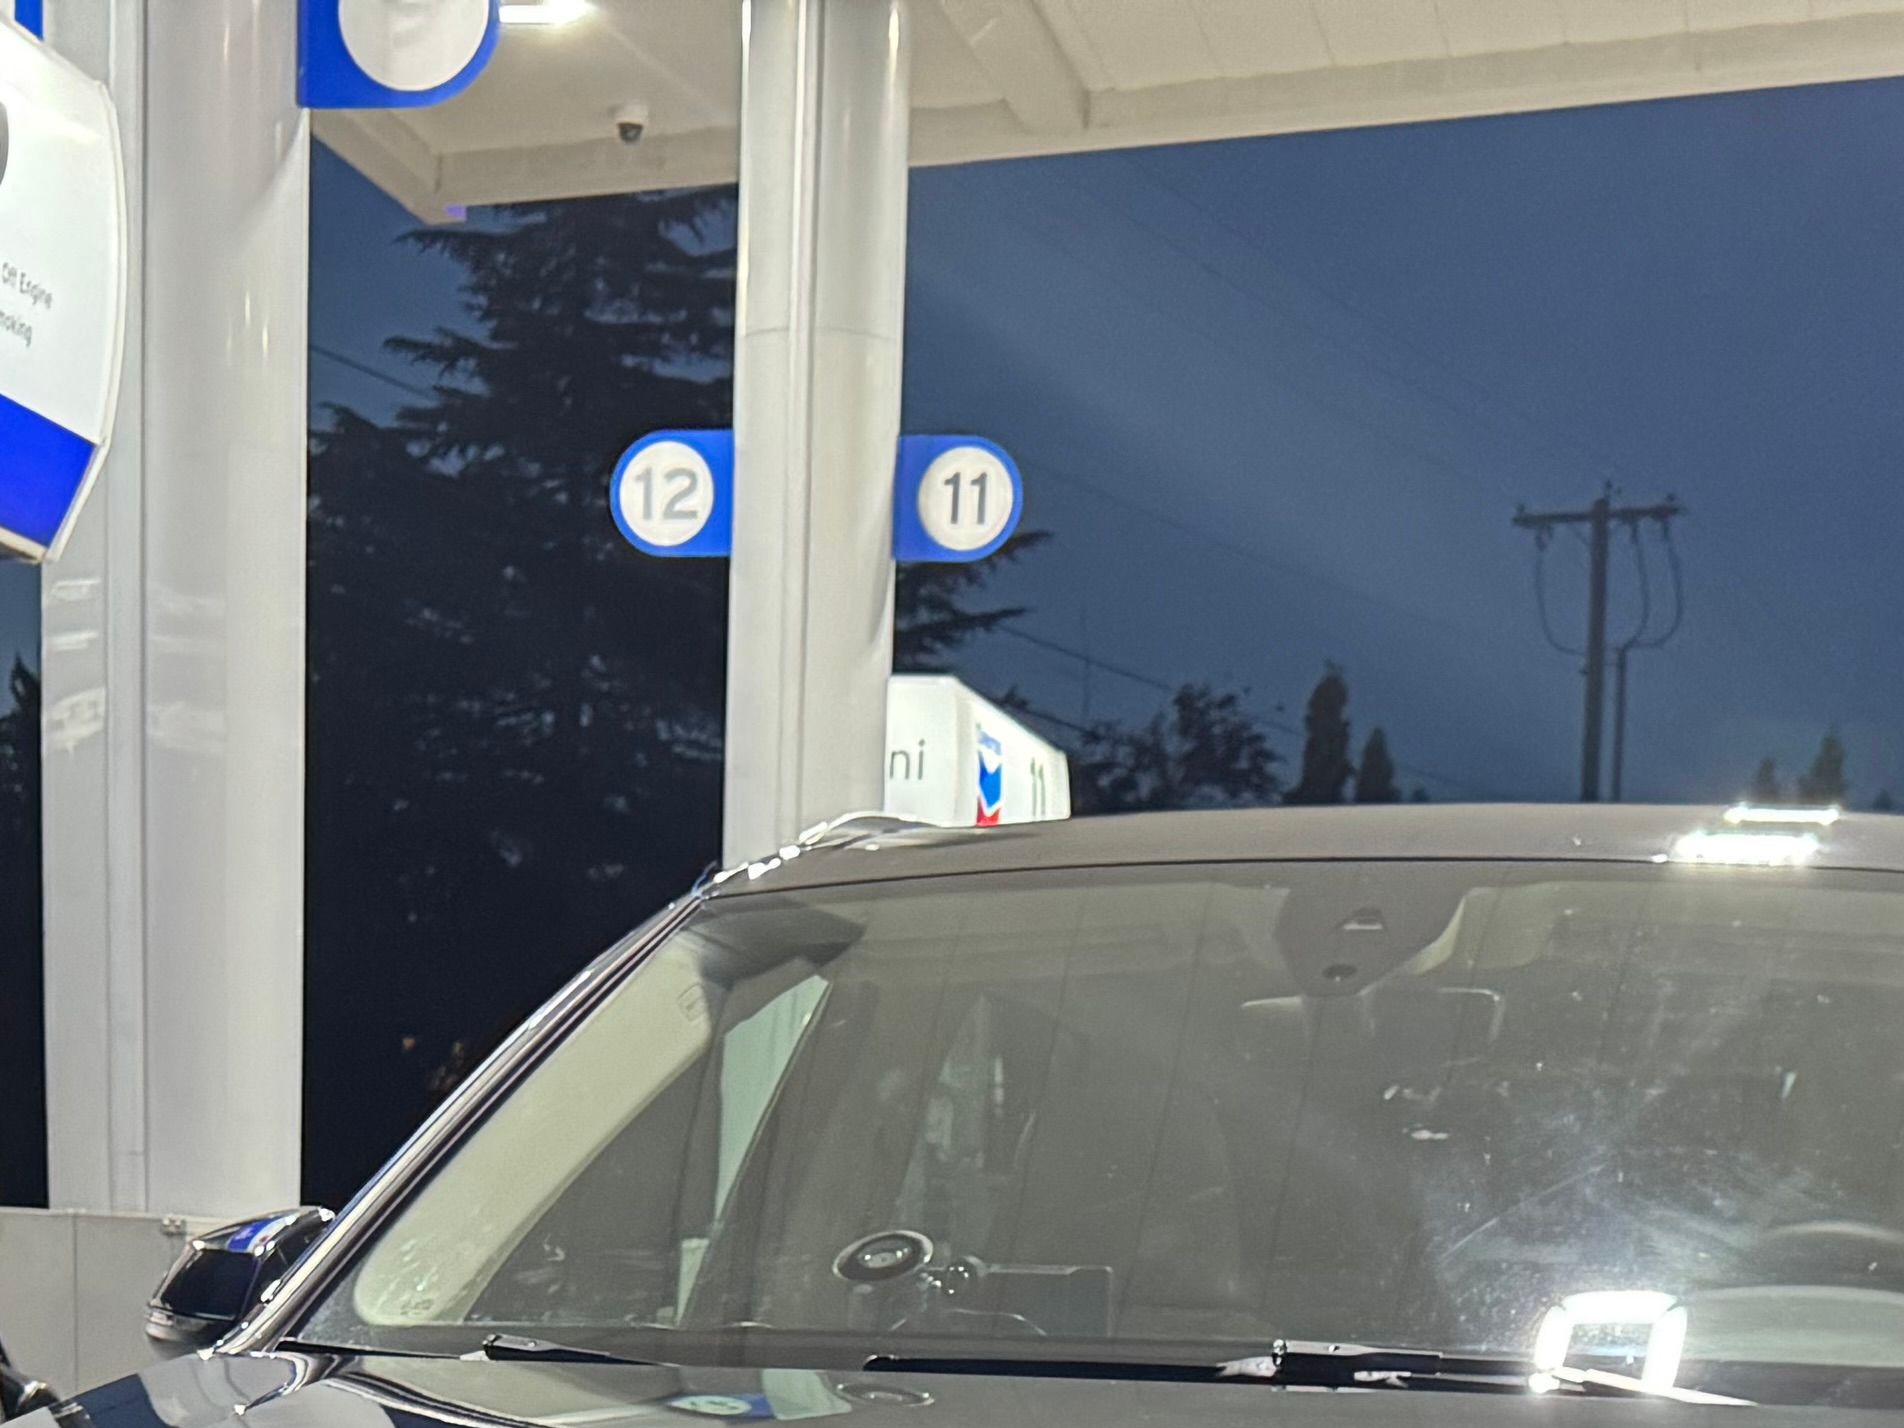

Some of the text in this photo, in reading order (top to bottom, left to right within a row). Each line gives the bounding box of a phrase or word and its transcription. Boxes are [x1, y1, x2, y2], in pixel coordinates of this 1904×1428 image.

[19, 271, 53, 310] Engine
[634, 466, 699, 521] 12
[943, 471, 989, 525] 11
